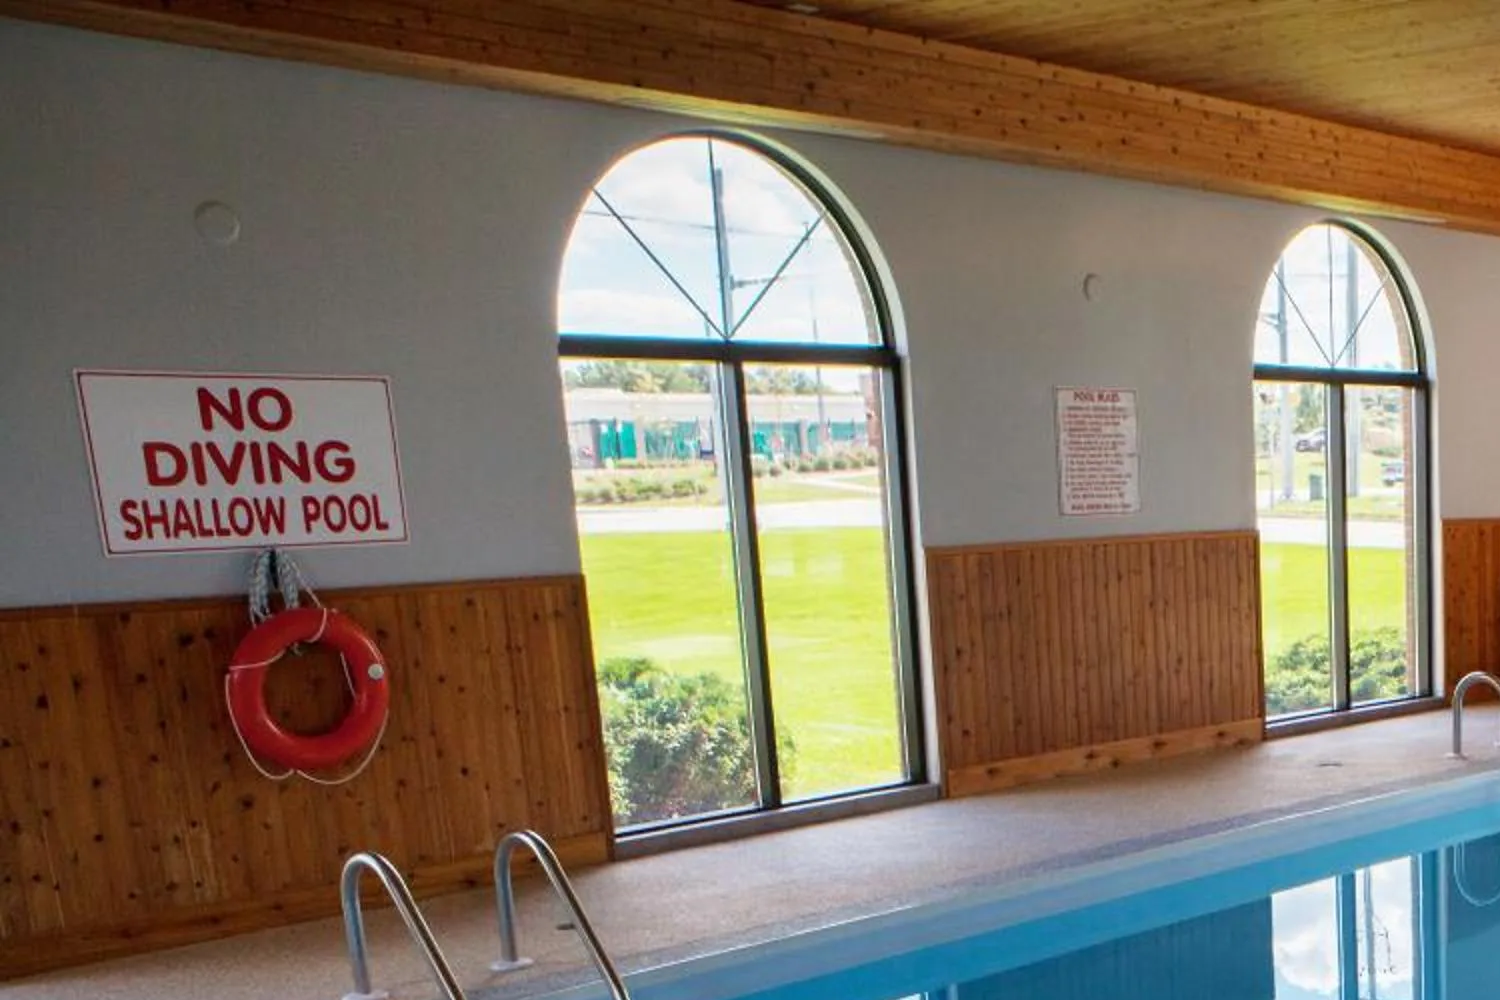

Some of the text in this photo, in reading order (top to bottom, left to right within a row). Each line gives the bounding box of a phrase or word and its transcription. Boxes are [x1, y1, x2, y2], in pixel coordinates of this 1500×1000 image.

[196, 386, 293, 432] NO
[142, 440, 356, 487] DIVING
[119, 493, 390, 541] SHALLOW POOL
